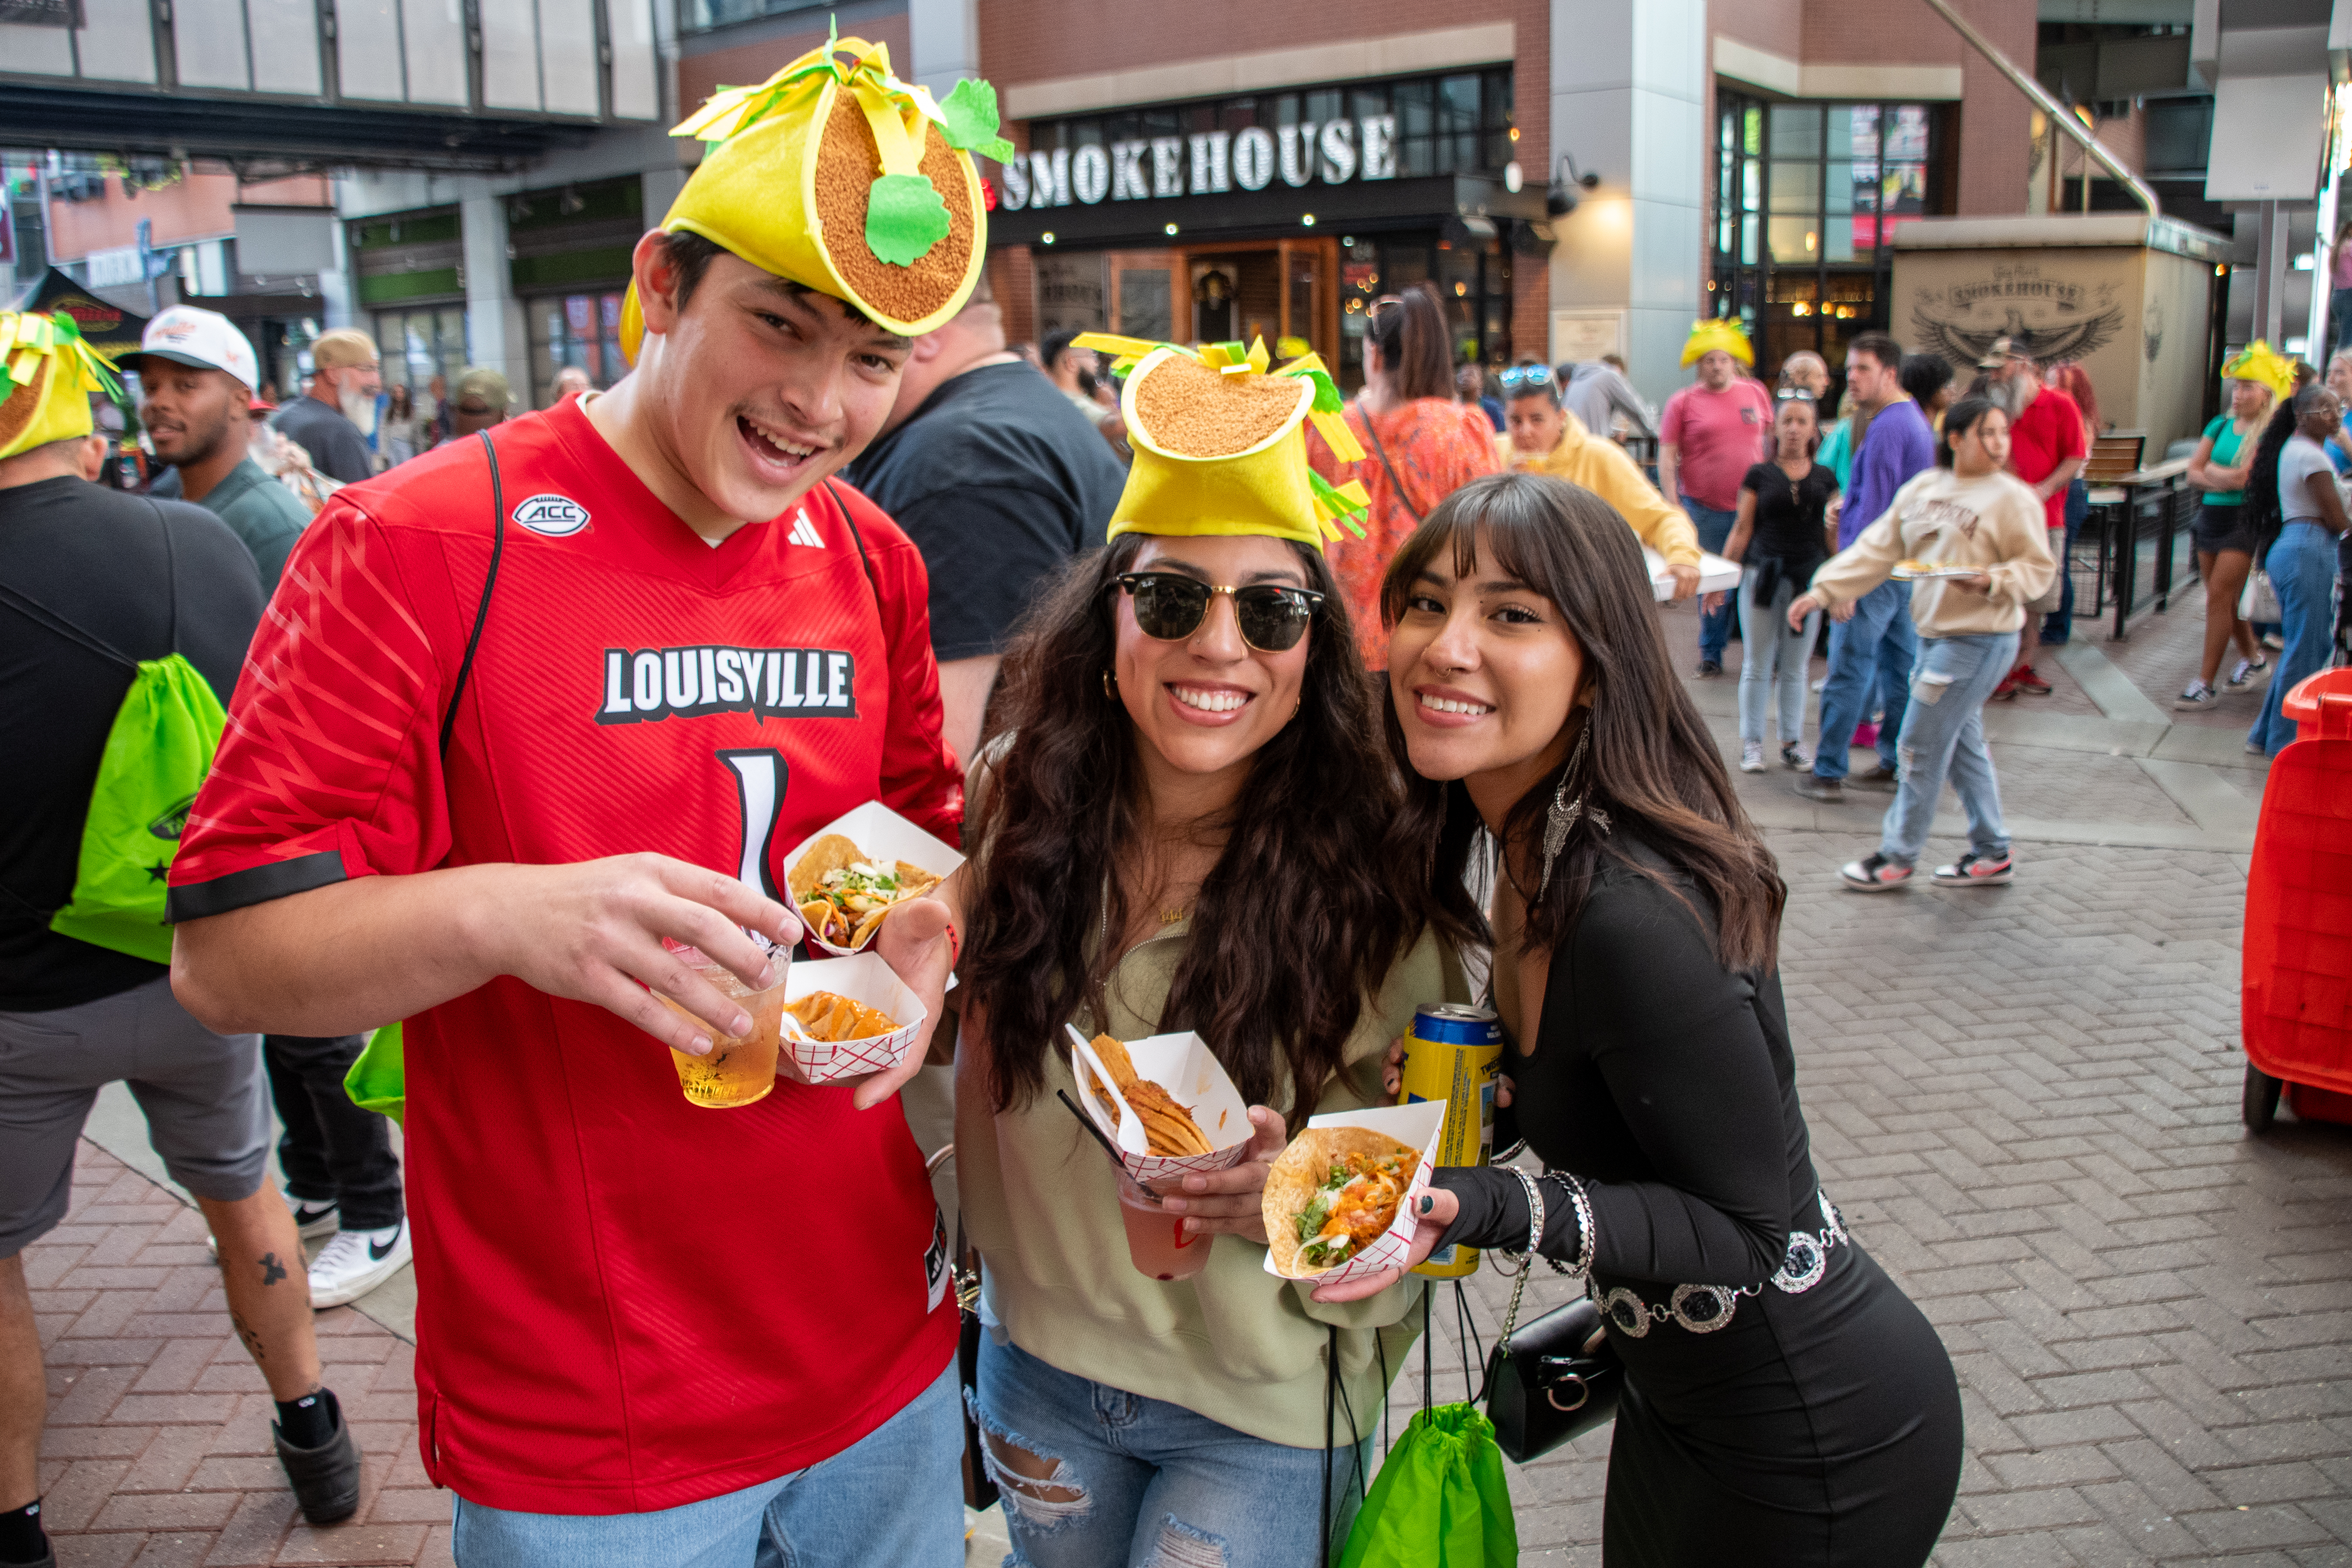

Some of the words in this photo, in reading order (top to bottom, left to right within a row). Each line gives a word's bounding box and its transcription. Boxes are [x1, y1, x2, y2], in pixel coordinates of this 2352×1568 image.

[1002, 113, 1395, 210] SMOKEHOUSE
[527, 506, 576, 519] ACC
[600, 647, 852, 716] LOUISVILLE
